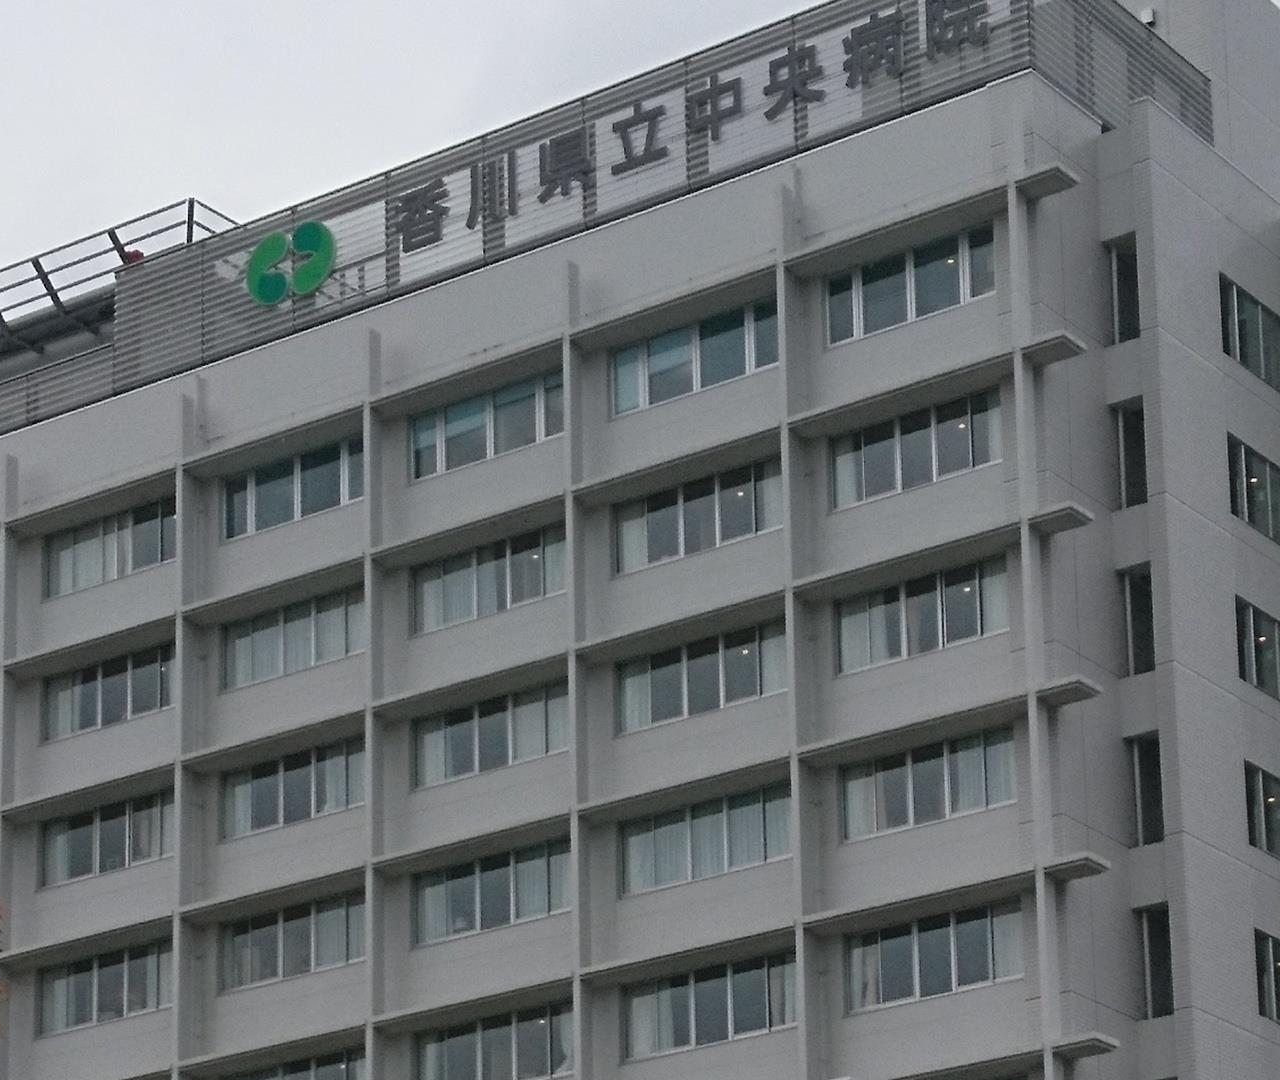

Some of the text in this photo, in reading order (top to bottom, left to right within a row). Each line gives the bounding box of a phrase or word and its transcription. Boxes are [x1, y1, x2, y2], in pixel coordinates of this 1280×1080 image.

[394, 0, 989, 253] 香川県立中央病院
